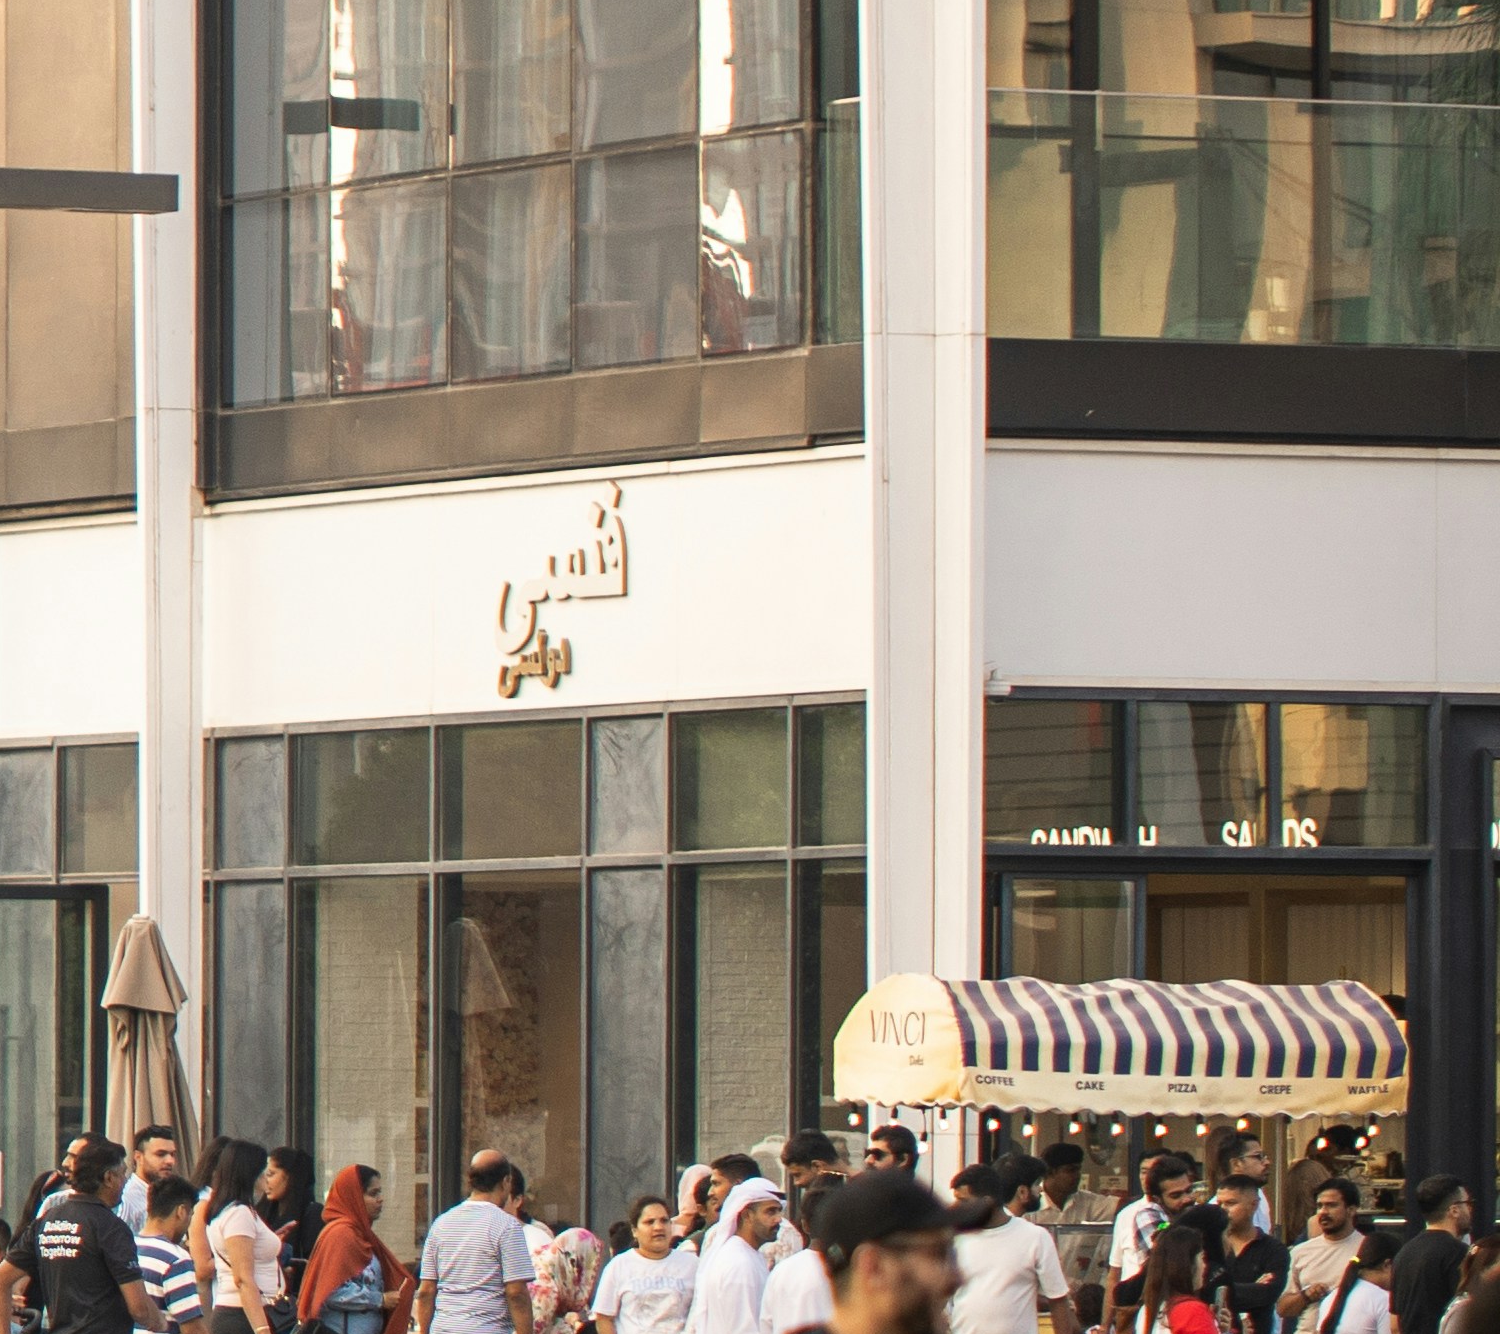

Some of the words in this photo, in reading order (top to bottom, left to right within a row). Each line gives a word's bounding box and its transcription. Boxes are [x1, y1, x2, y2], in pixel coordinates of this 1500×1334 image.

[870, 1010, 926, 1046] VINCI
[975, 1074, 1015, 1086] COFFEE
[1075, 1080, 1105, 1091] CAKE
[1168, 1083, 1197, 1093] PIZZA
[1259, 1085, 1291, 1095] CREPE
[1347, 1083, 1389, 1095] WAFFLE
[44, 1220, 79, 1234] Building
[39, 1234, 81, 1244] Tomorrow
[40, 1246, 77, 1259] Together
